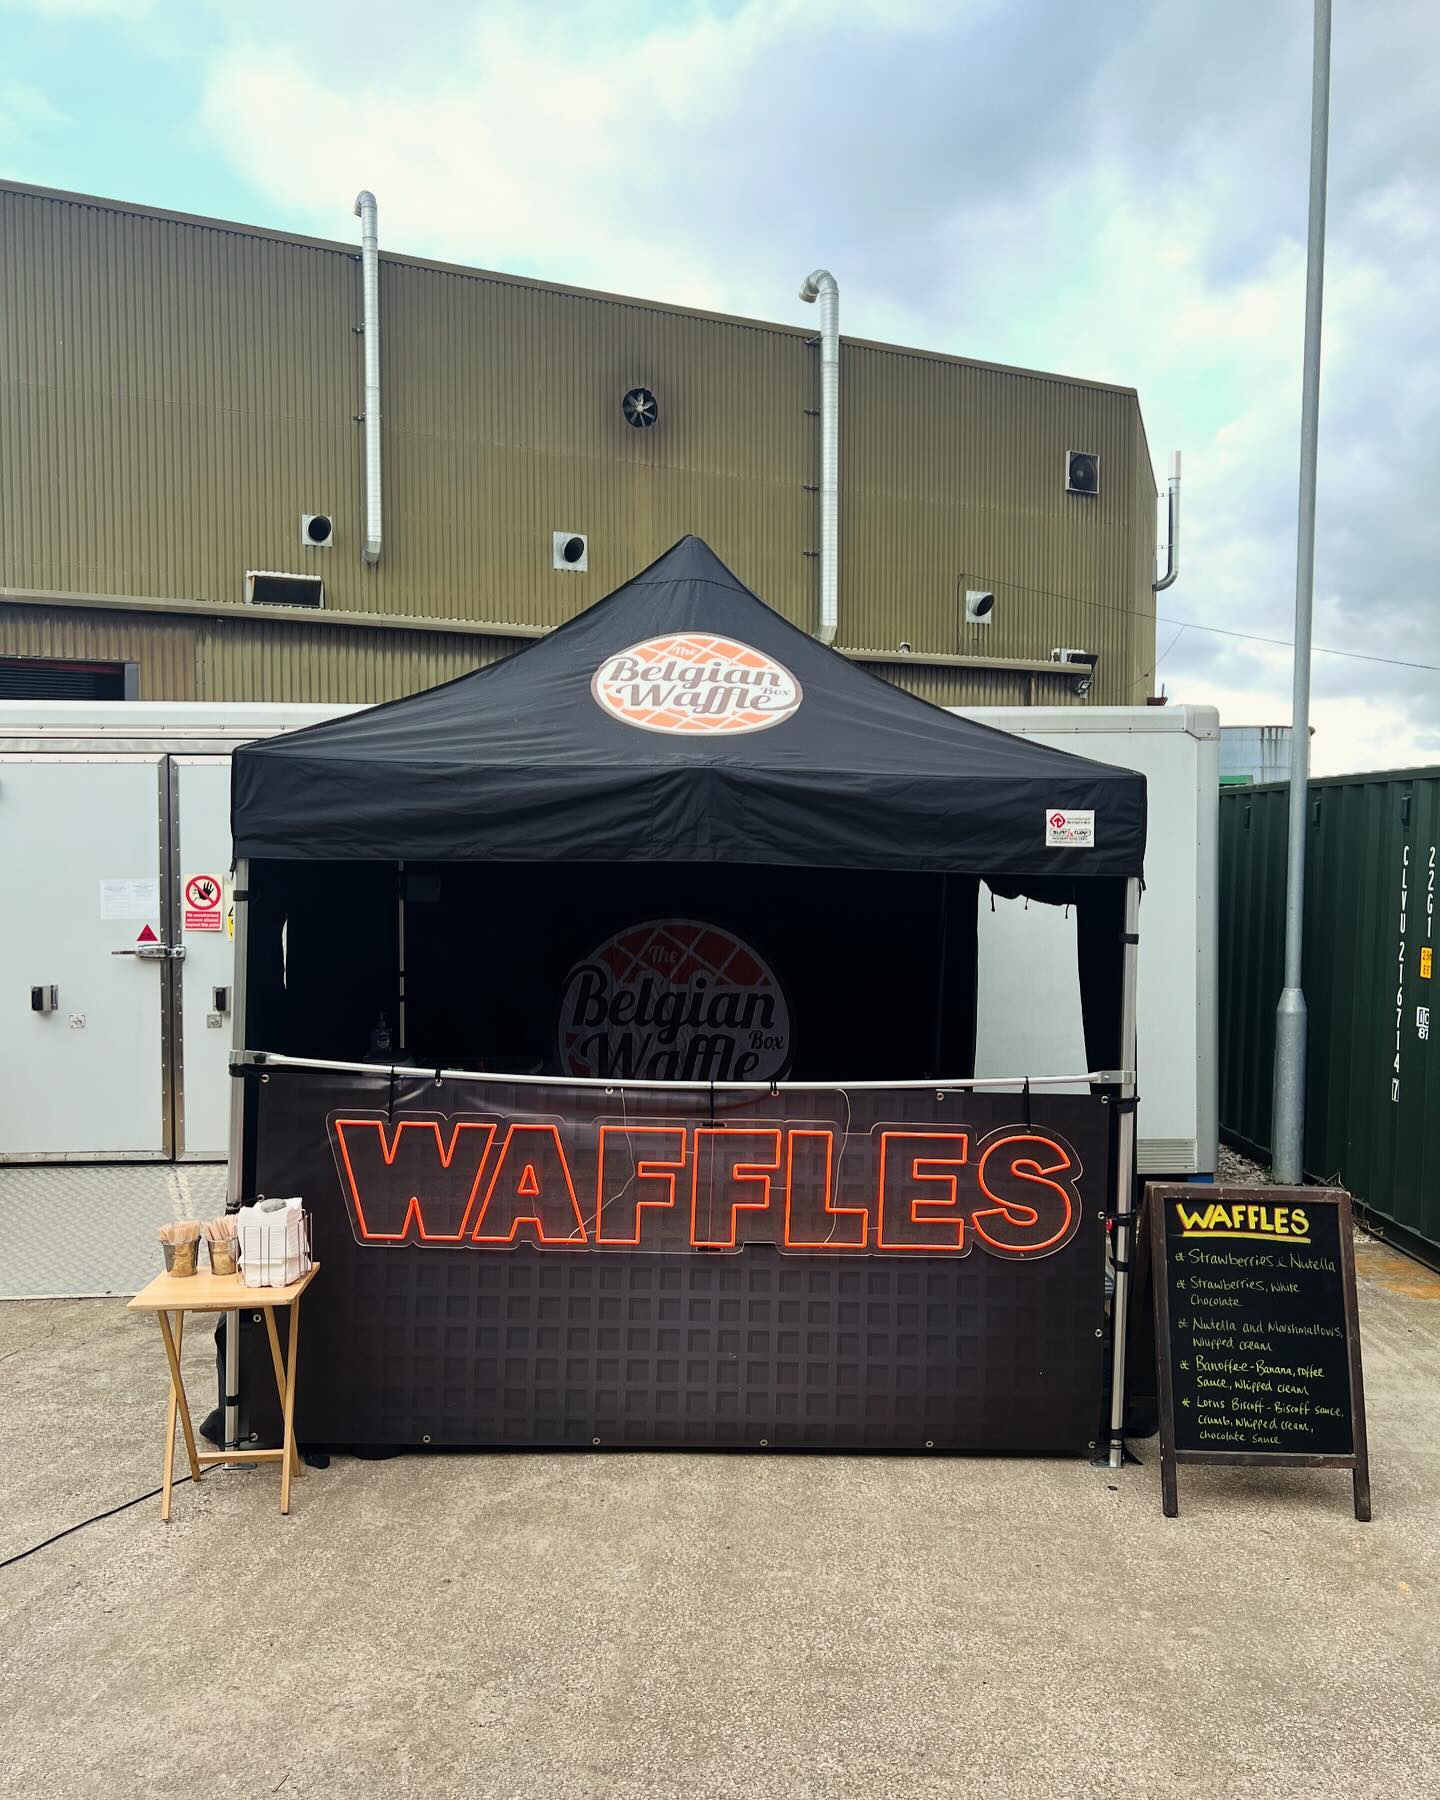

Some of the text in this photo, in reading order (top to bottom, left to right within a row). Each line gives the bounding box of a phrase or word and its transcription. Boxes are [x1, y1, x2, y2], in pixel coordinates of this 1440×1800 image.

[669, 646, 698, 656] The
[600, 656, 781, 690] Belgian
[615, 684, 774, 714] Waffle
[1400, 845, 1410, 934] CLVU
[1426, 846, 1435, 938] 22G1
[648, 944, 679, 964] The
[563, 964, 776, 1044] Belgian
[1393, 941, 1405, 1073] 216714
[749, 1029, 784, 1050] Box
[580, 1032, 760, 1081] Waffle
[334, 1118, 1073, 1252] WAFFLES
[1176, 1203, 1310, 1235] WAFFLES
[1188, 1249, 1275, 1268] Strawberries
[1289, 1253, 1337, 1273] Nutella
[1190, 1276, 1269, 1293] Strawberries,
[1192, 1317, 1237, 1332] Nutella
[1242, 1320, 1265, 1334] and
[1196, 1395, 1226, 1409] Lotus
